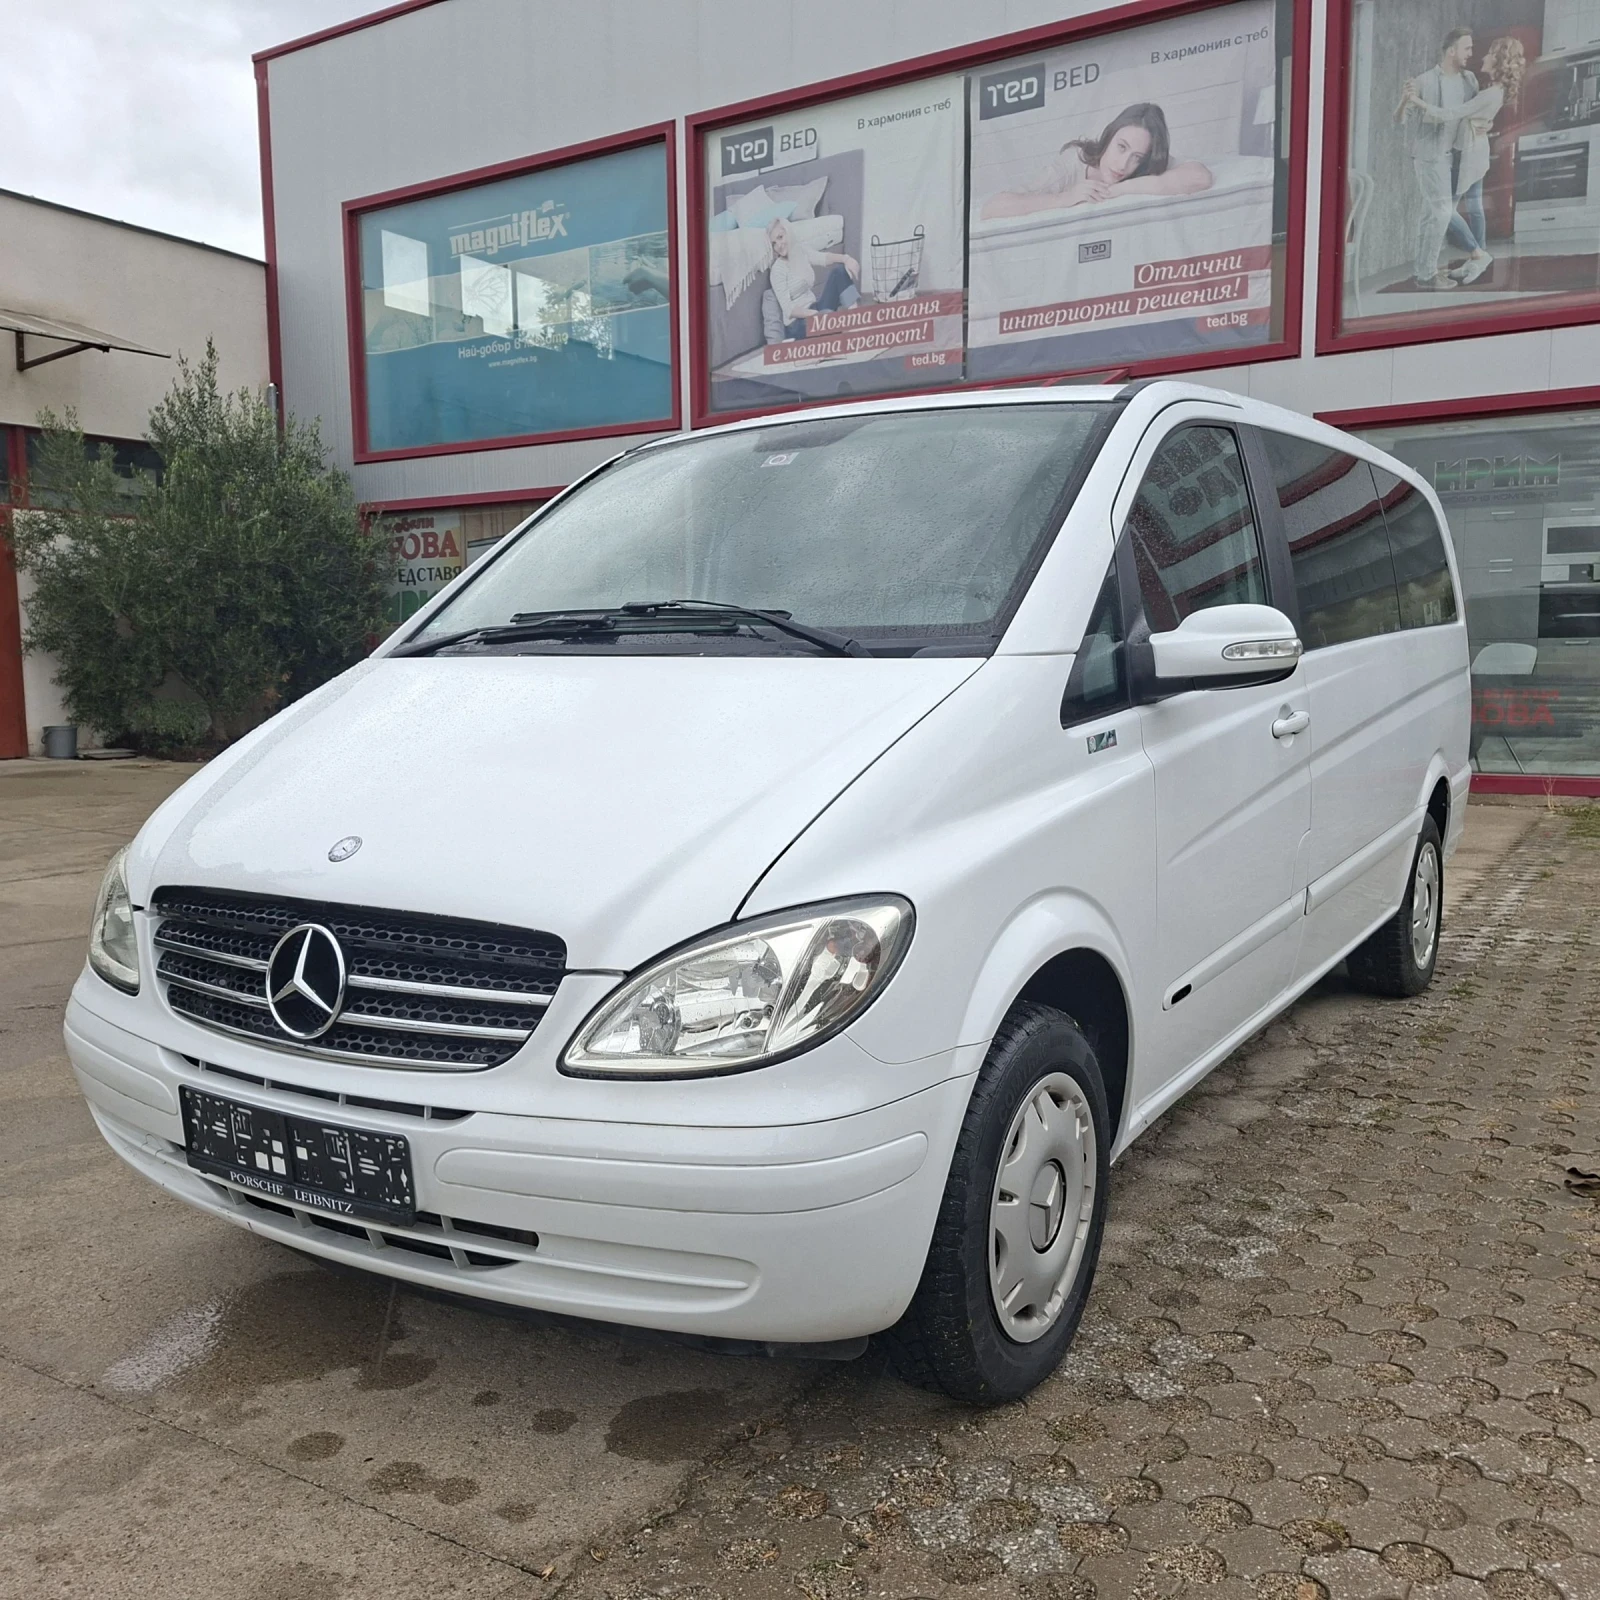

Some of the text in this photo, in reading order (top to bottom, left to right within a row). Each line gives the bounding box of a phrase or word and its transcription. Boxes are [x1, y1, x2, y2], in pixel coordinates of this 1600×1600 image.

[1150, 26, 1269, 64] В хармония с теб
[1053, 63, 1101, 91] BED
[857, 97, 951, 130] В хармония с теб
[780, 127, 817, 152] BED
[449, 209, 568, 255] magniflex
[1137, 254, 1243, 285] Отлични
[810, 299, 941, 333] Моята спалня
[1002, 277, 1242, 332] интериорни решения!
[1206, 313, 1249, 328] ted.bg
[458, 340, 511, 359] Най-добър
[772, 322, 929, 363] е моята крепост!
[911, 352, 946, 366] ted.bg
[397, 565, 462, 587] ЕДСТАВЯ
[229, 1170, 354, 1214] PORSCHE LEIBNITZ
